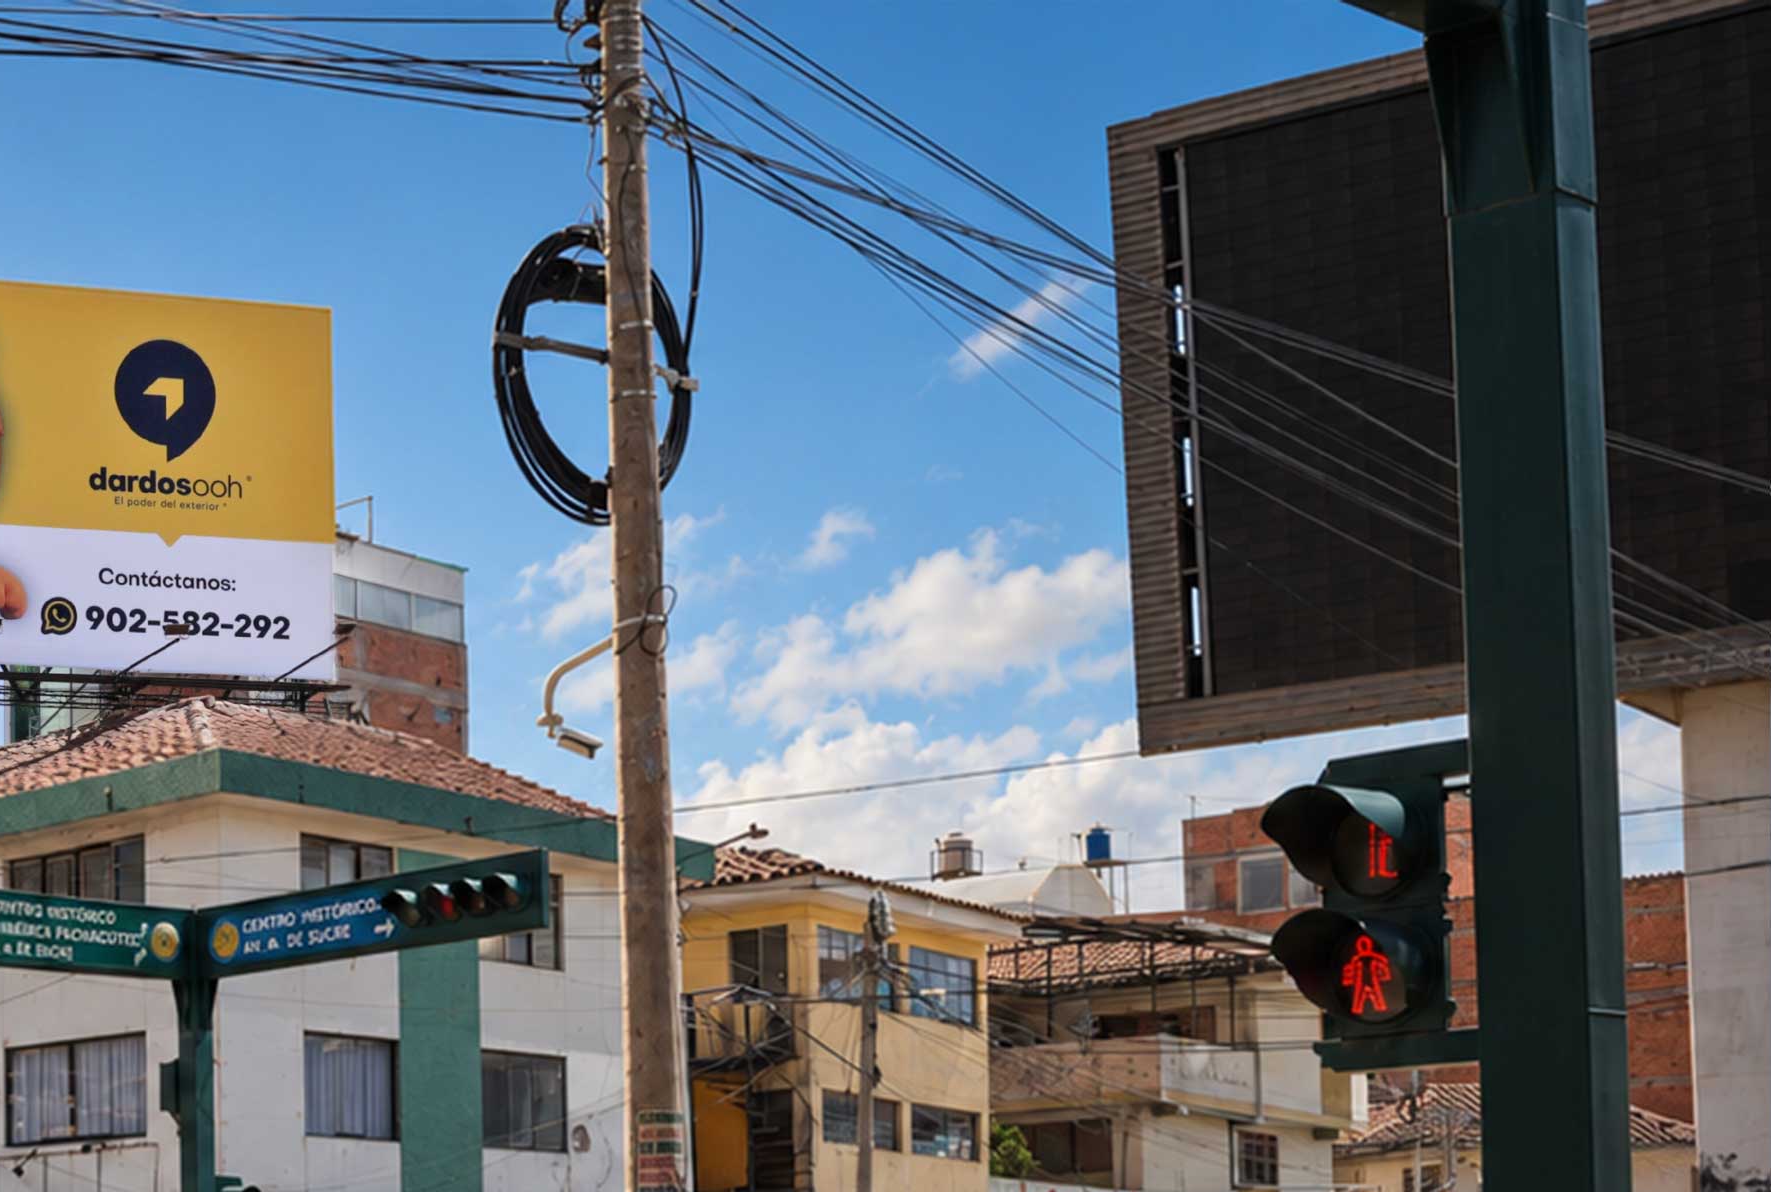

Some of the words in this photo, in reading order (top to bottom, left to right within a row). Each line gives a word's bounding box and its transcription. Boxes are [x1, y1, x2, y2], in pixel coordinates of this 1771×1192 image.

[89, 466, 243, 499] dardosooh
[114, 496, 124, 505] El
[127, 497, 157, 508] poder
[160, 500, 177, 509] del
[179, 501, 220, 511] exterior
[98, 567, 237, 592] Contáctanos:
[85, 605, 291, 640] 902-582-292
[242, 912, 296, 934] CENTRO
